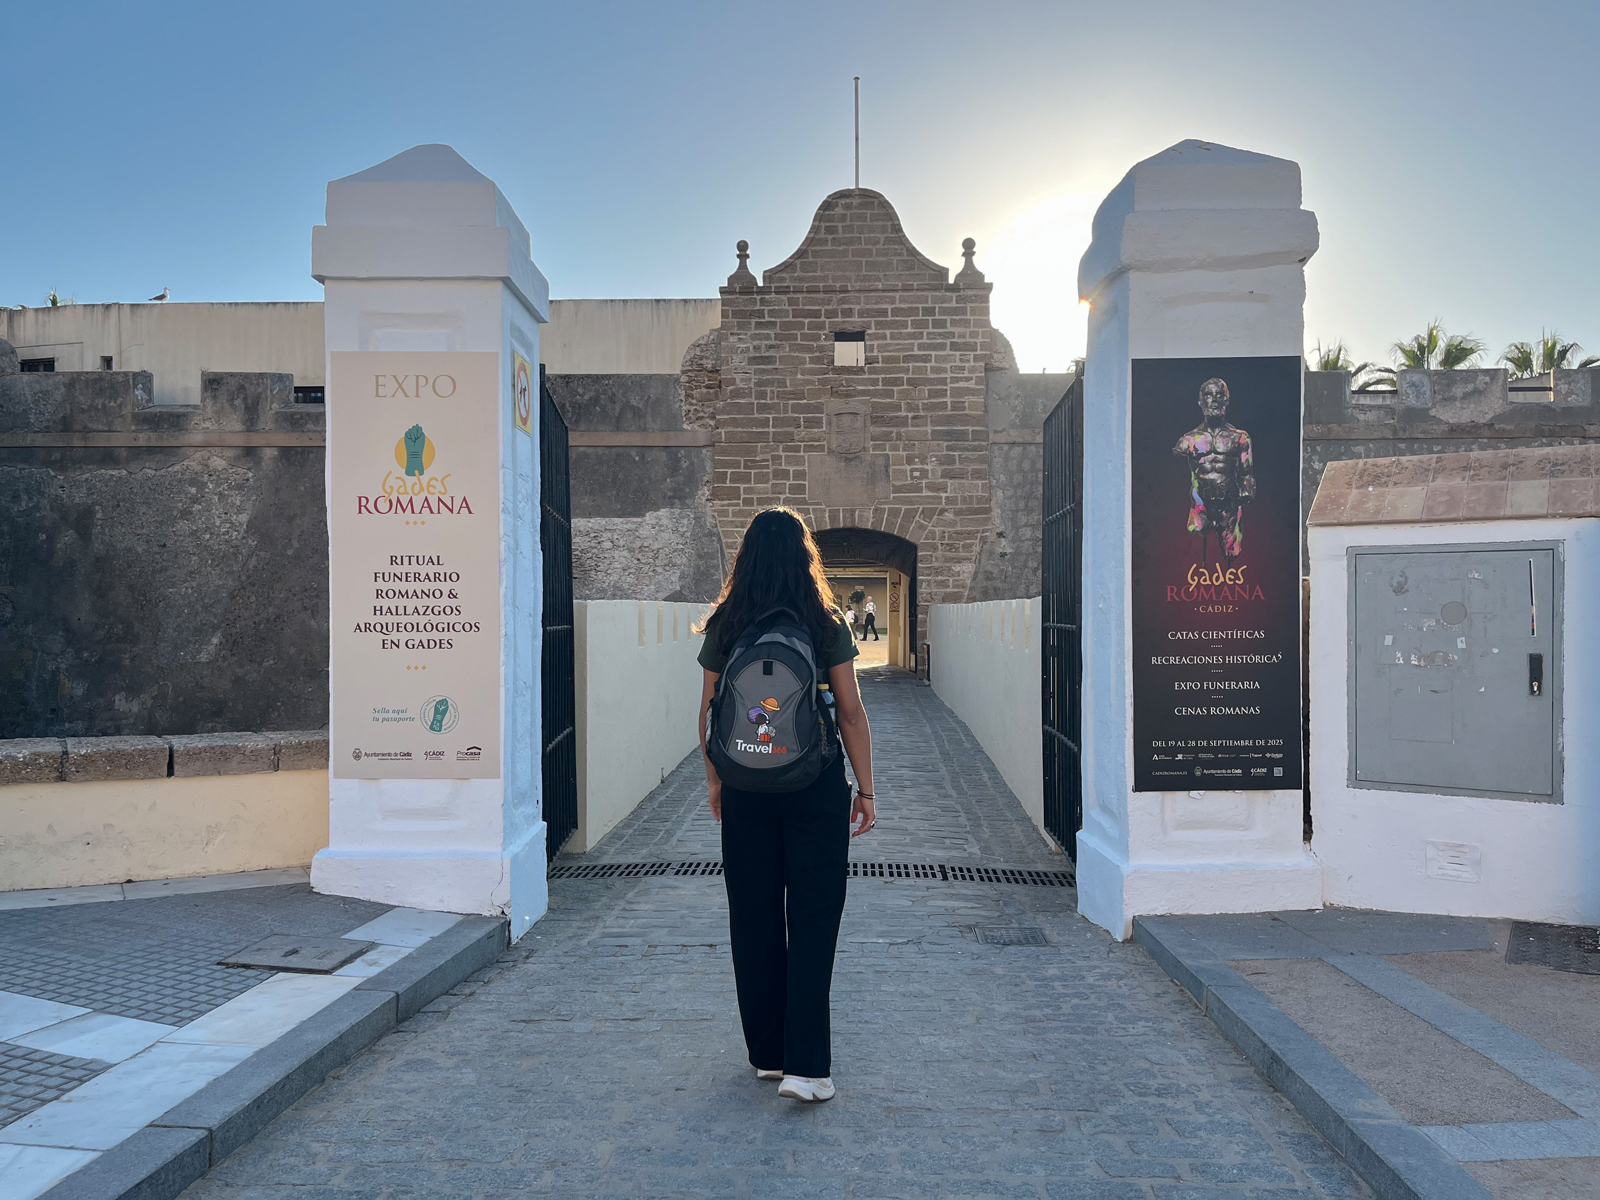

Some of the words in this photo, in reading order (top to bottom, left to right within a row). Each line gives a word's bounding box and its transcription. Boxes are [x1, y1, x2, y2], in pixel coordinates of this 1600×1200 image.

[373, 374, 457, 399] EXPO
[381, 470, 452, 502] Gades
[356, 494, 475, 515] ROMANA
[389, 555, 445, 566] RITUAL
[373, 571, 461, 583] FUNERARIO
[1187, 563, 1248, 592] Gades
[375, 588, 444, 600] ROMANO
[447, 588, 459, 600] &
[1166, 584, 1266, 602] ROMANA
[372, 605, 462, 617] HALLAZGOS
[1199, 603, 1235, 613] CÁDIZ
[353, 619, 481, 635] ARQUEOLÓGICOS
[1168, 630, 1199, 640] CATAS
[1201, 628, 1265, 640] CIENTÍFICAS
[381, 638, 401, 650] EN
[404, 638, 454, 650] GADES
[1151, 655, 1223, 665] RECREACIONES
[1174, 681, 1201, 691] EXPO
[1203, 680, 1261, 690] FUNERARIA
[391, 707, 408, 715] aquí
[1174, 707, 1208, 716] CENAS
[1210, 706, 1261, 715] ROMANAS
[1152, 740, 1167, 748] DEL
[1209, 739, 1254, 747] SEPTIEMBRE
